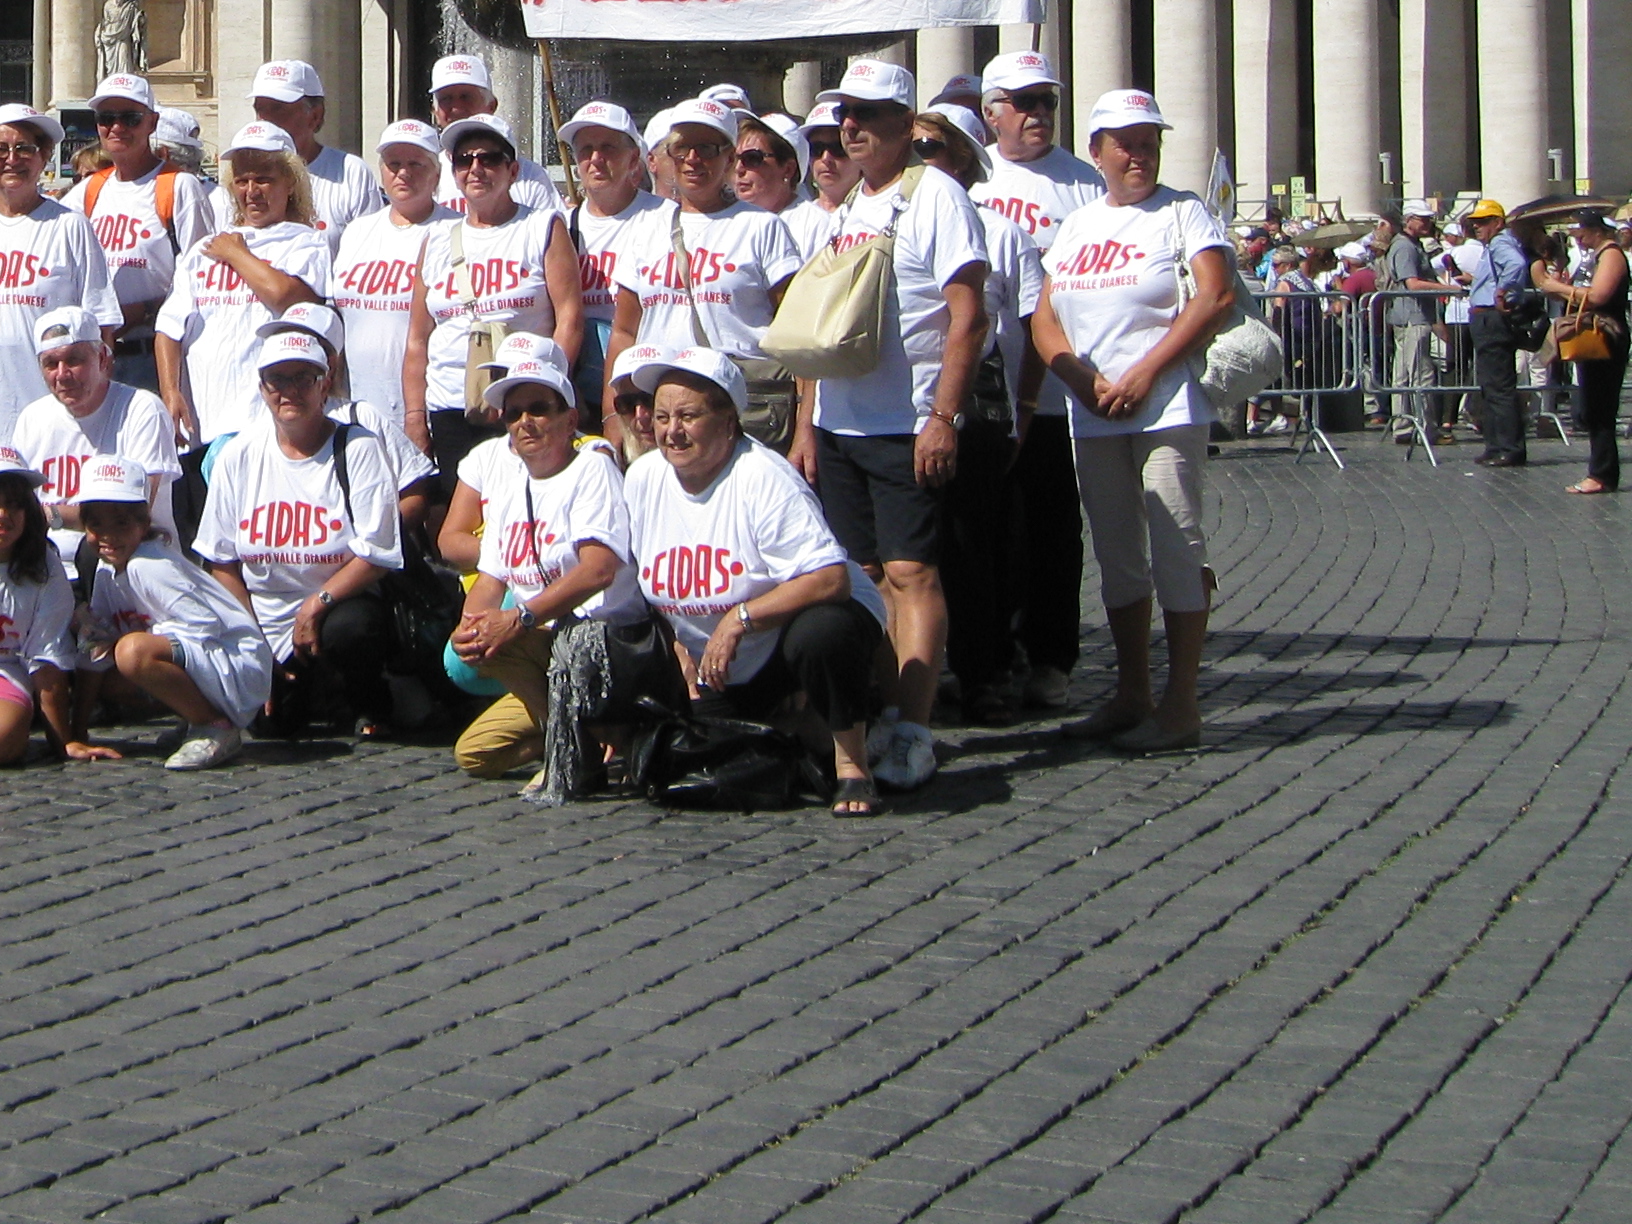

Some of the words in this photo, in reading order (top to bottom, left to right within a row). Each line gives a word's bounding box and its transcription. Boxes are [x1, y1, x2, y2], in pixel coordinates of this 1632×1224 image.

[344, 259, 416, 296] FIDAS
[446, 258, 519, 300] FDAS
[1070, 279, 1097, 292] VALLE
[1100, 275, 1139, 288] DIANESE
[13, 294, 47, 308] DIANESE
[364, 299, 389, 311] VALLE
[390, 300, 410, 312] DIAN
[498, 296, 535, 311] DIANESE
[42, 455, 92, 499] FID
[249, 501, 328, 549] FIDAS
[273, 552, 301, 564] VALLE
[652, 544, 731, 600] FIDAS
